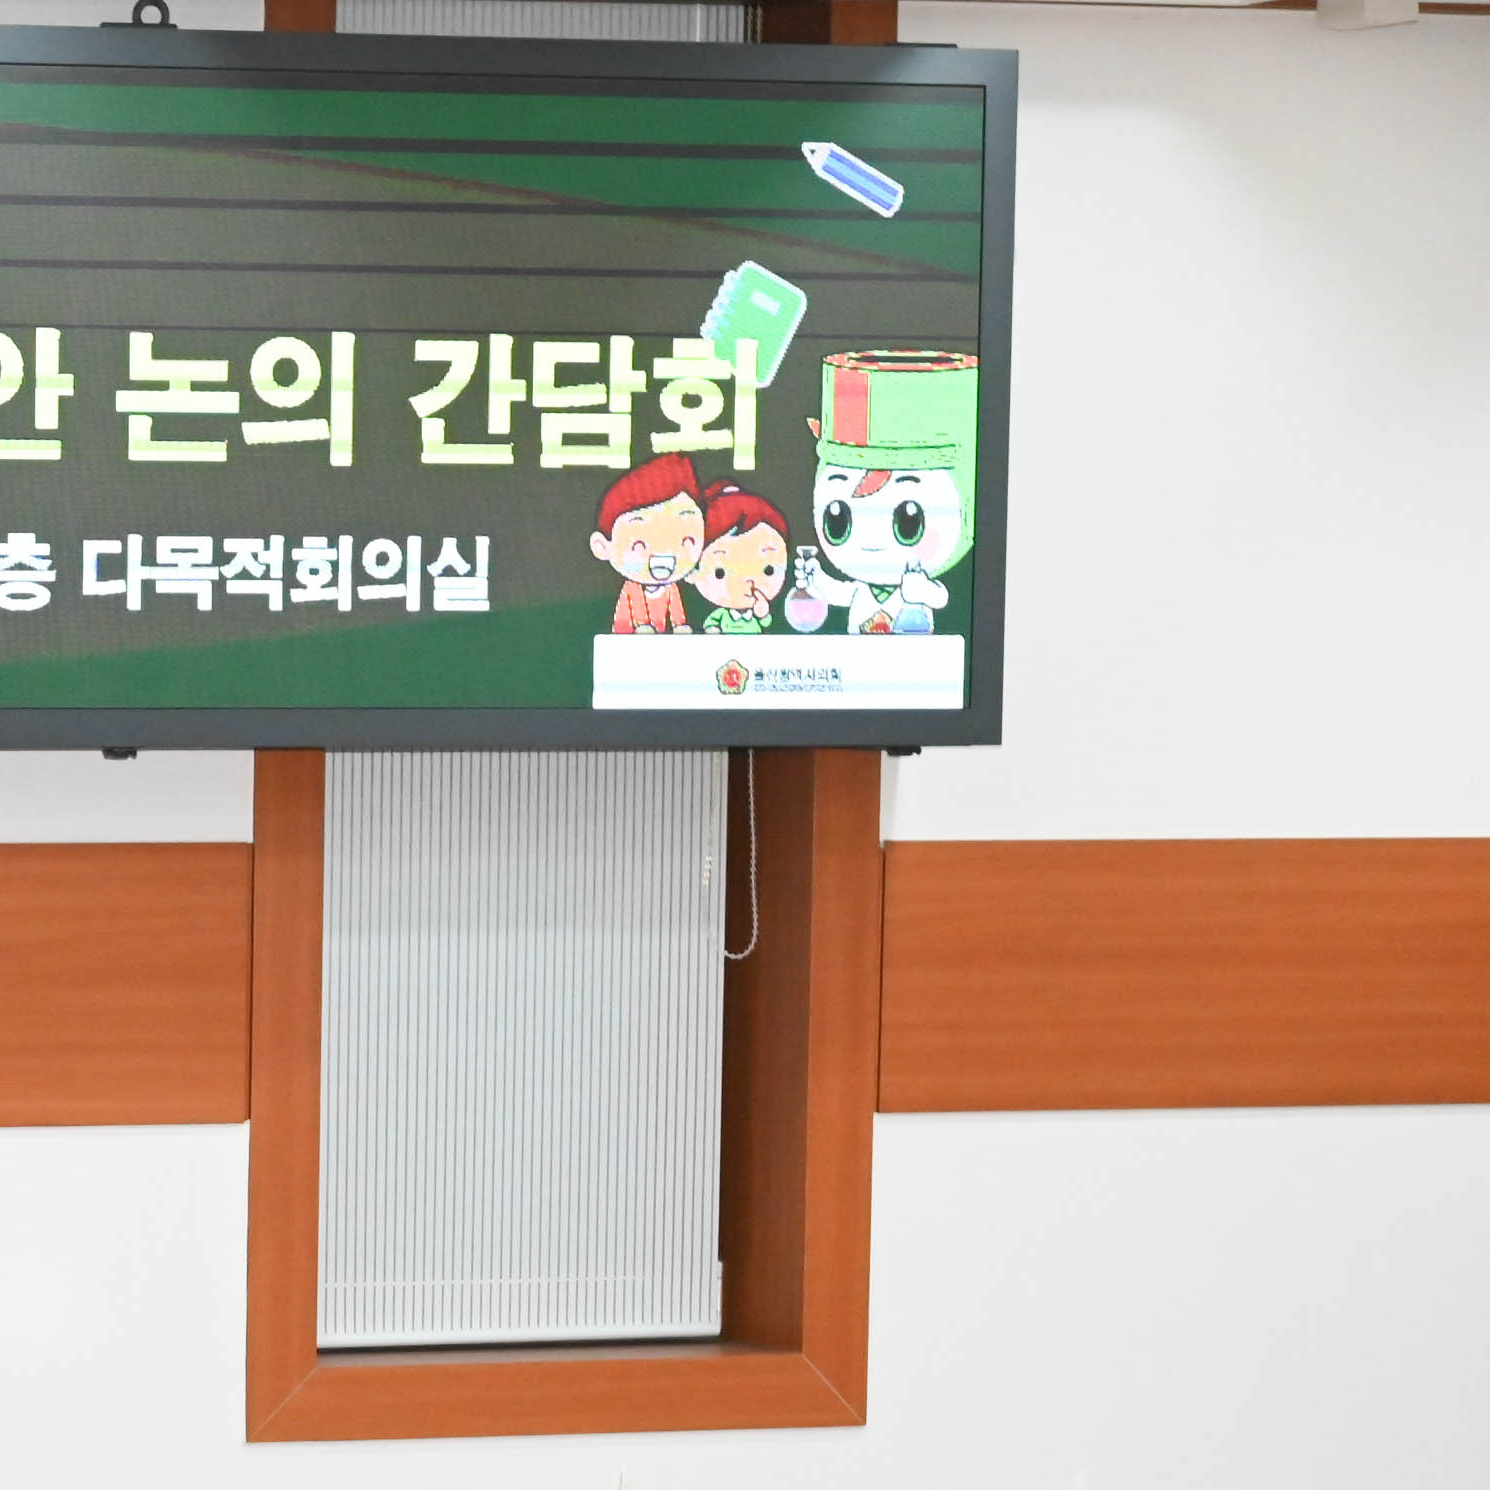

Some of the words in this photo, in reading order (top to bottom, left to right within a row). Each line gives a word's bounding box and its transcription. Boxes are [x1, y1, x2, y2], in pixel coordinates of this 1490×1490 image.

[116, 332, 355, 466] 논의
[410, 333, 760, 470] 간담회
[83, 534, 489, 611] 다목적회의실
